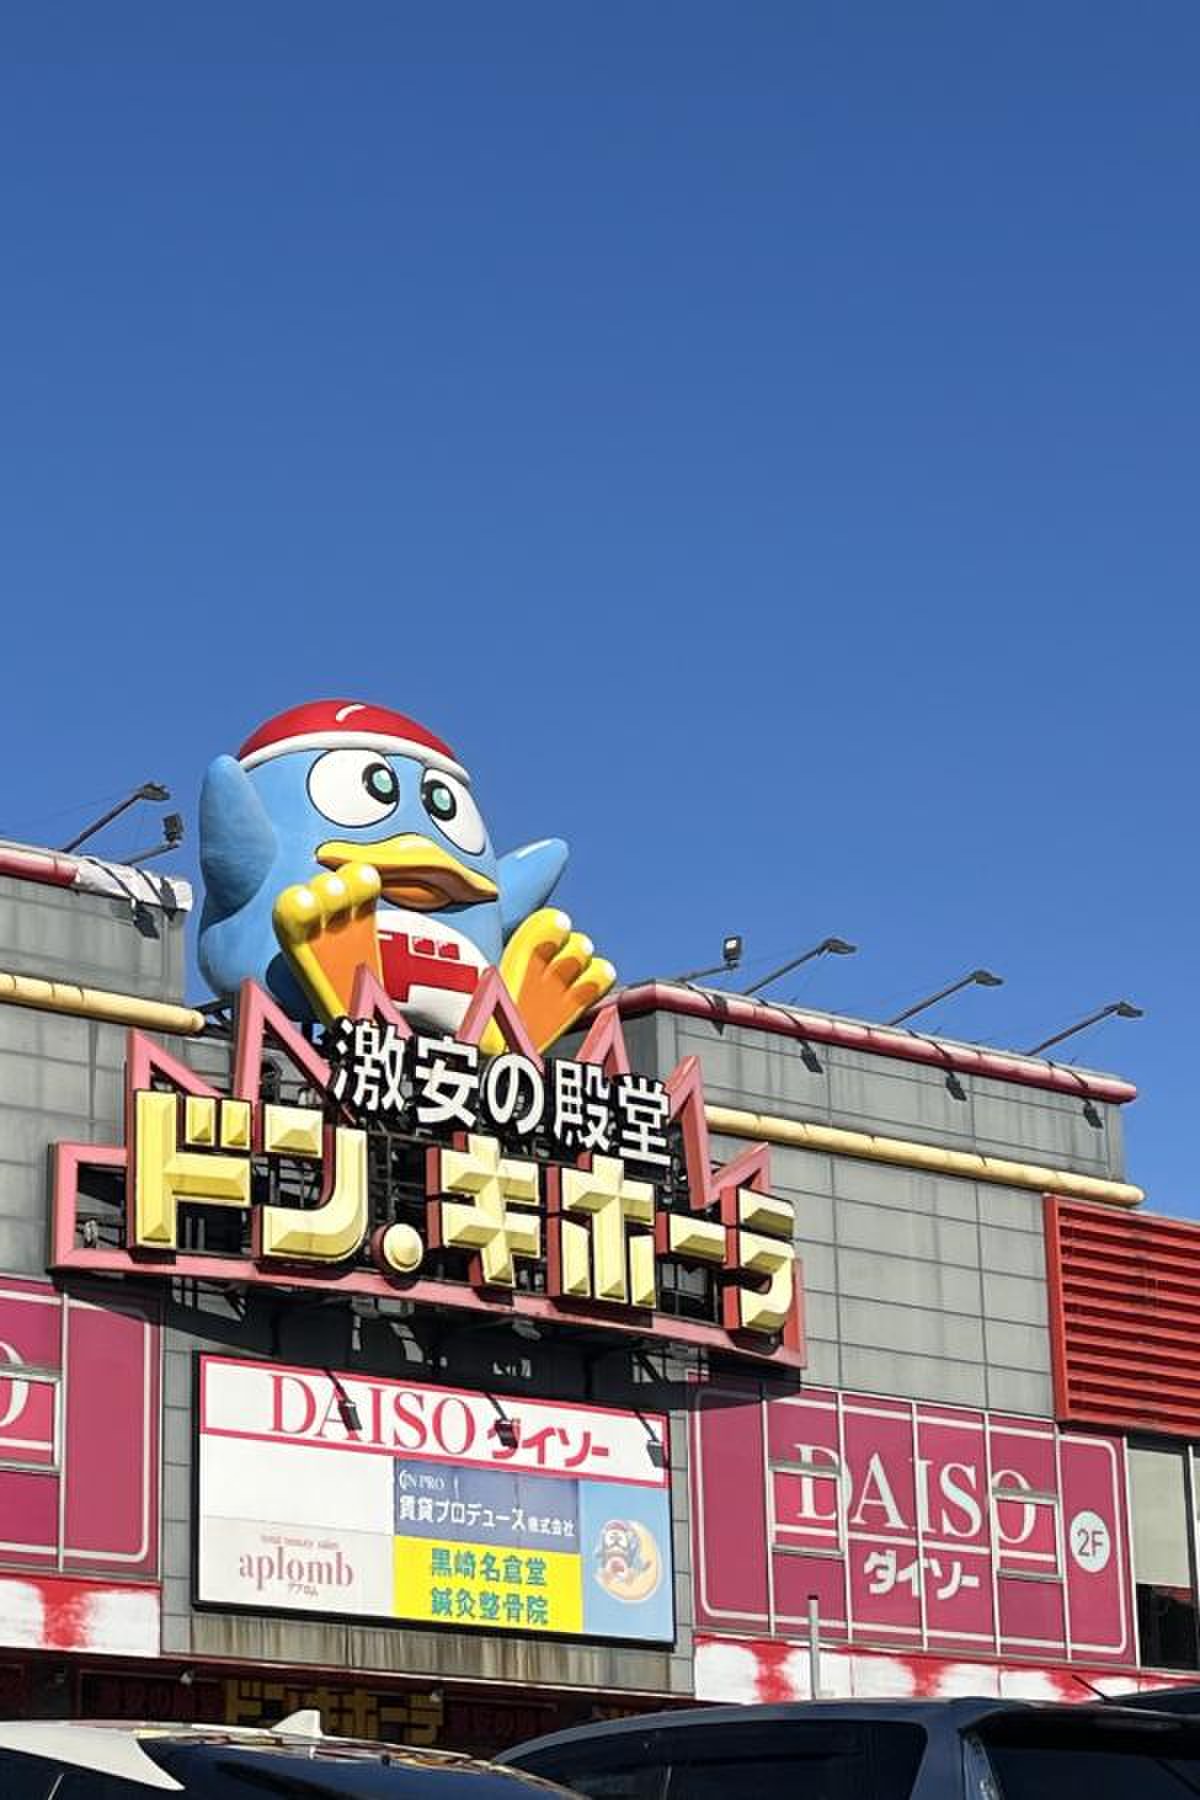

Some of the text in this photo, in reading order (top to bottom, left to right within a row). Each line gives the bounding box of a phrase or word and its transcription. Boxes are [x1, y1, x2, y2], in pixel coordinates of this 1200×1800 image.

[334, 1018, 672, 1167] 激安の殿堂
[270, 1373, 477, 1455] DAISO
[793, 1443, 1037, 1545] DAISO
[239, 1546, 354, 1591] aplomb
[863, 1549, 980, 1600] ダイソー
[1076, 1528, 1105, 1559] 2F
